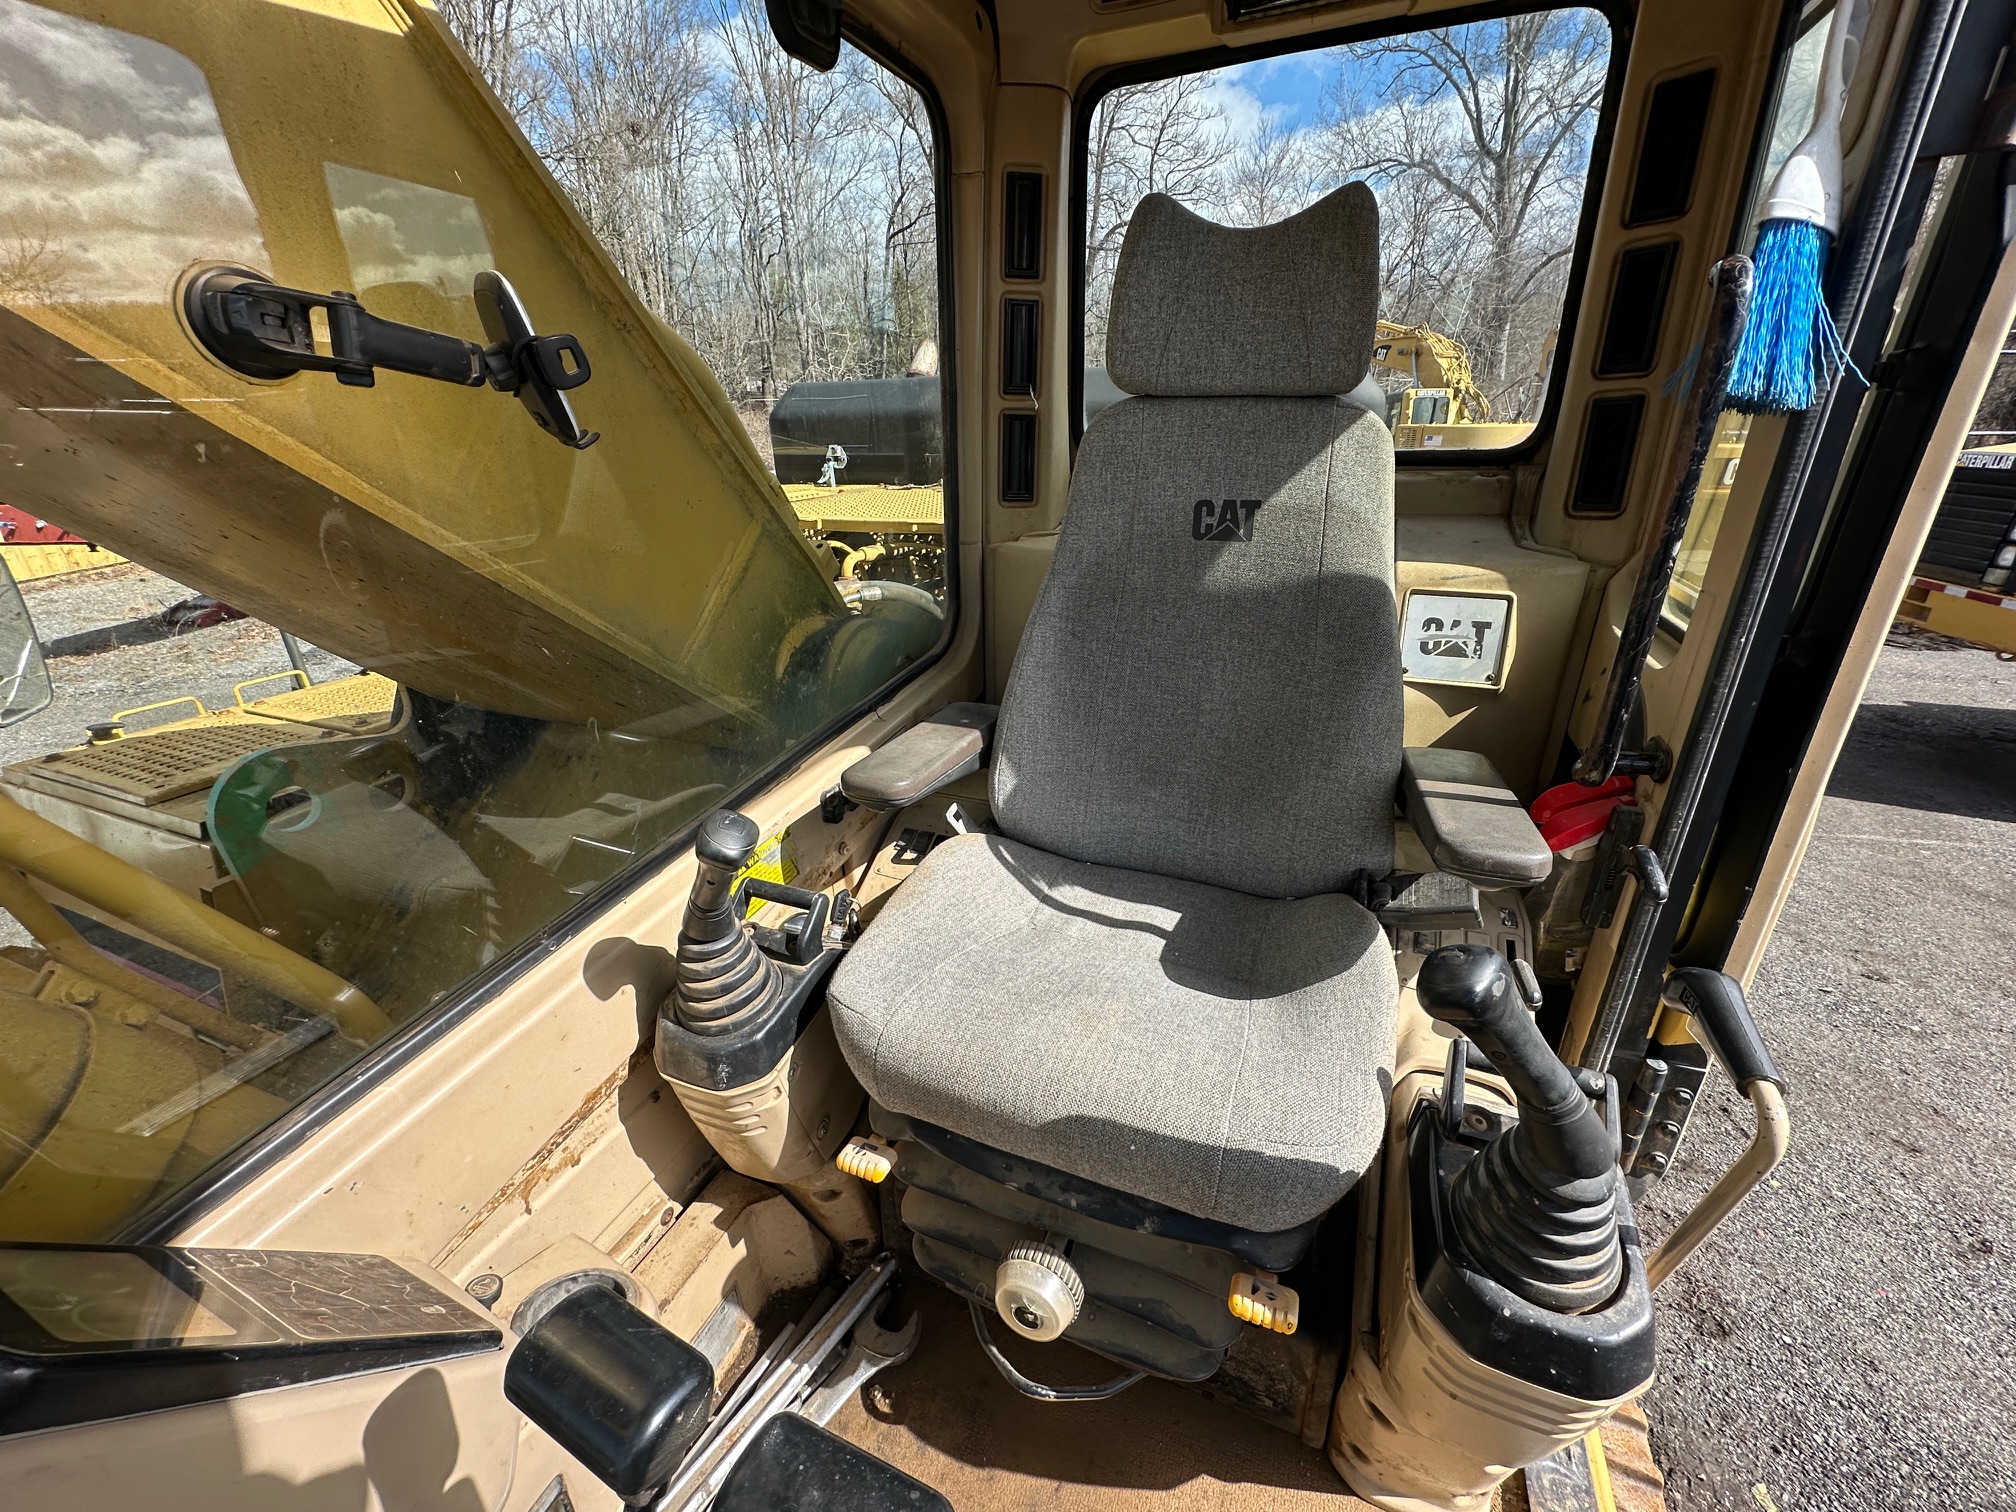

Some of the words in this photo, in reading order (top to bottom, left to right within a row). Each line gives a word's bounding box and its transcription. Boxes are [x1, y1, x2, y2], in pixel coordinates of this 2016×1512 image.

[1192, 499, 1262, 542] CAT
[1419, 616, 1493, 660] CAT
[1681, 990, 1700, 1014] CAT
